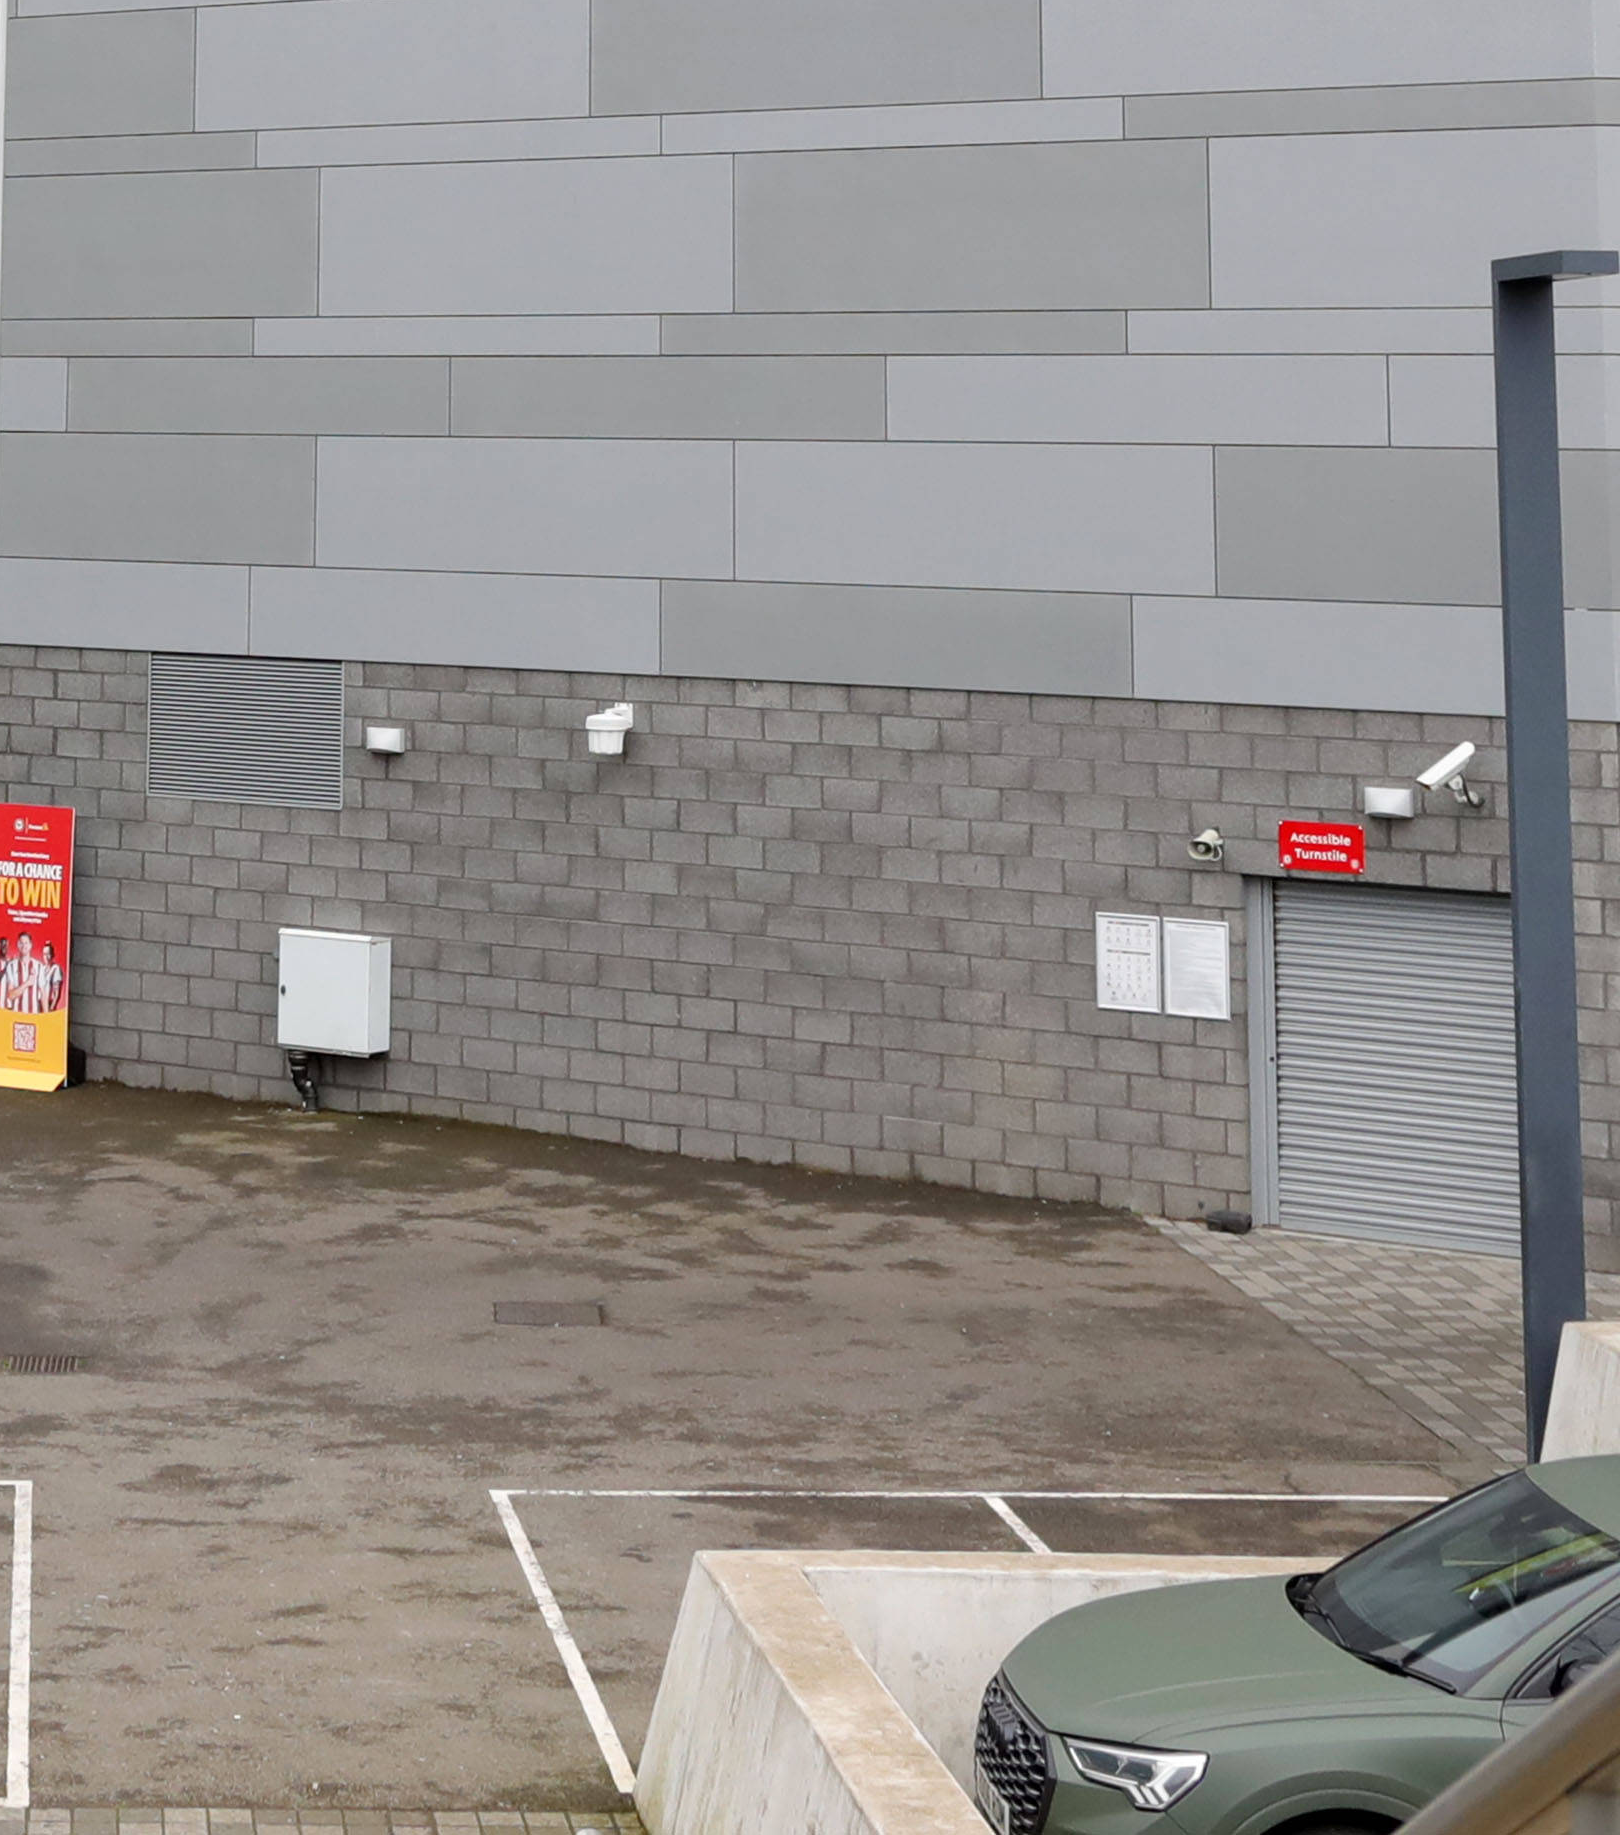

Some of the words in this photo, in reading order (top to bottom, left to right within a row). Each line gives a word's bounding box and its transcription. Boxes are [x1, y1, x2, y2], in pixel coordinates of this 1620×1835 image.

[1290, 832, 1352, 847] Accessible
[1294, 848, 1348, 863] Turnstile
[15, 862, 24, 878] A
[24, 862, 63, 881] CHANCE
[21, 878, 62, 910] WIN
